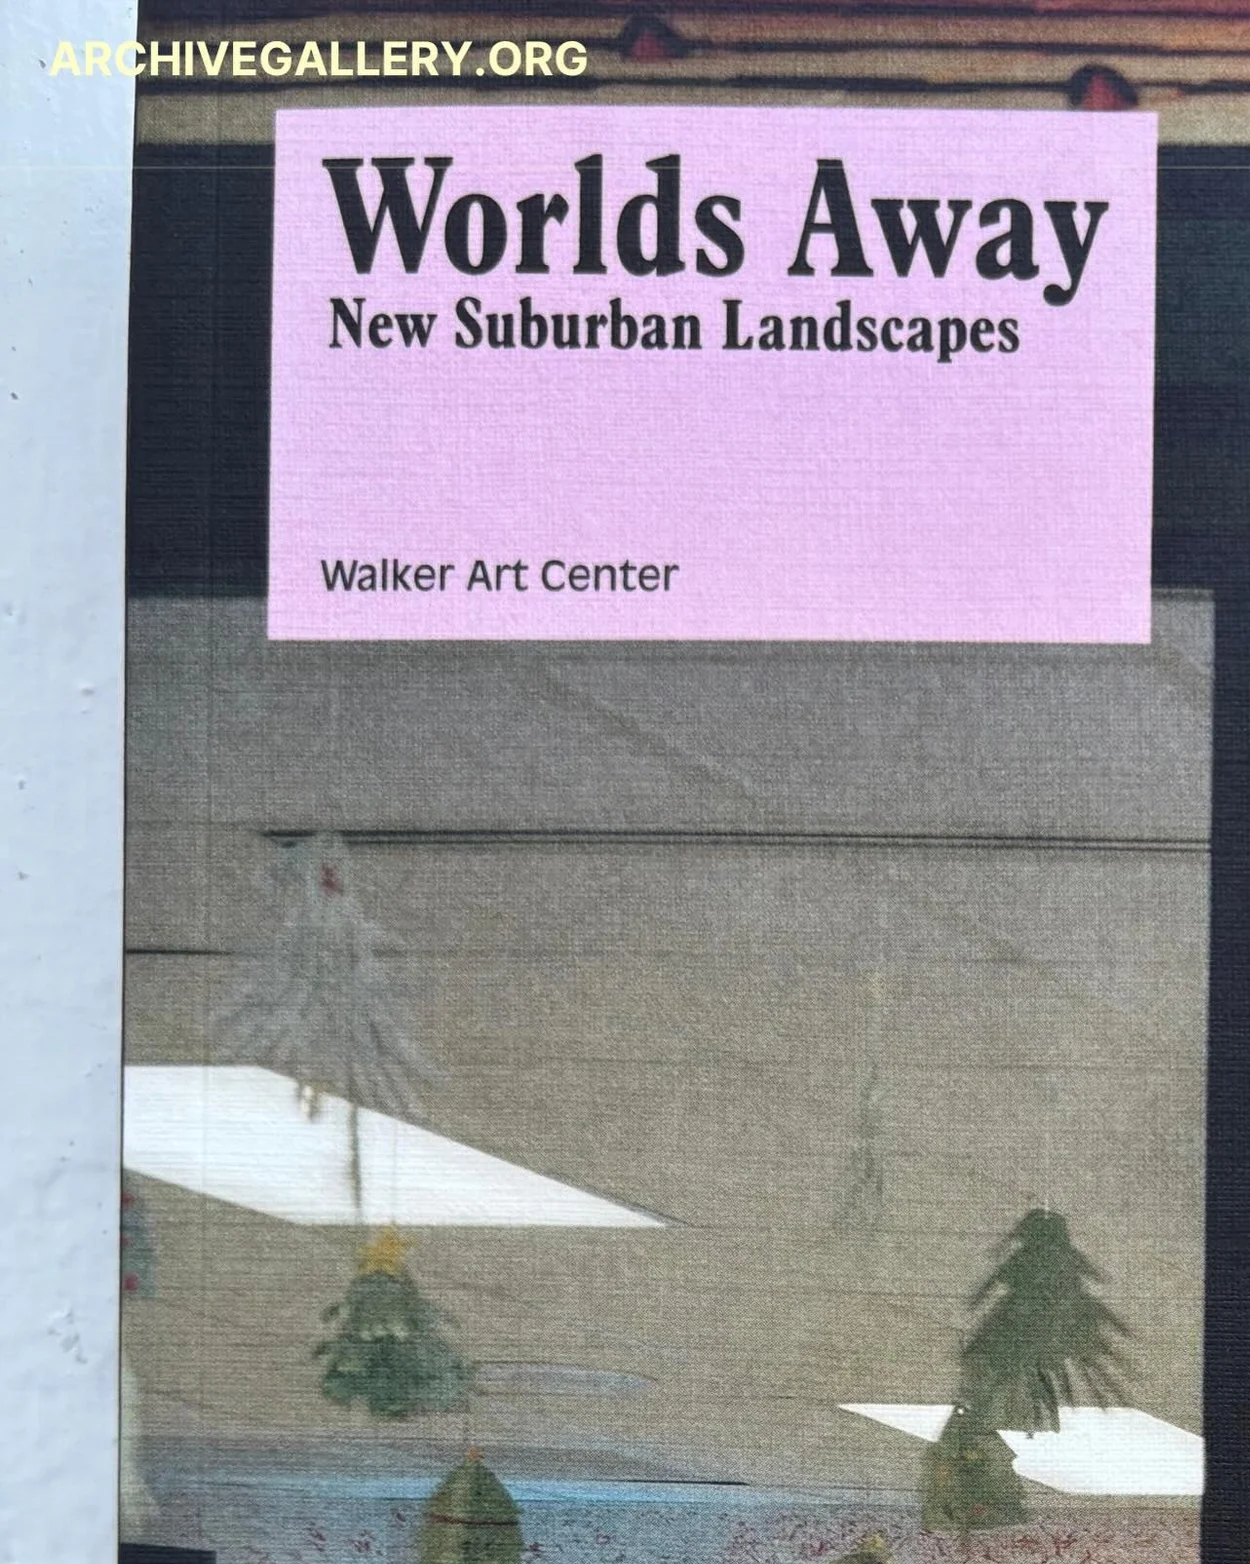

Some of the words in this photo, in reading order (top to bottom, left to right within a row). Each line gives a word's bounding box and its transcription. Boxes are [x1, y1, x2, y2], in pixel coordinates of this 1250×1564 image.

[321, 153, 745, 277] Worlds
[787, 158, 1109, 306] Away
[329, 297, 438, 349] New
[455, 296, 702, 351] Suburban
[722, 299, 1020, 363] Landscapes
[320, 558, 455, 592] Walker
[467, 559, 528, 592] Art
[541, 559, 679, 593] Center
